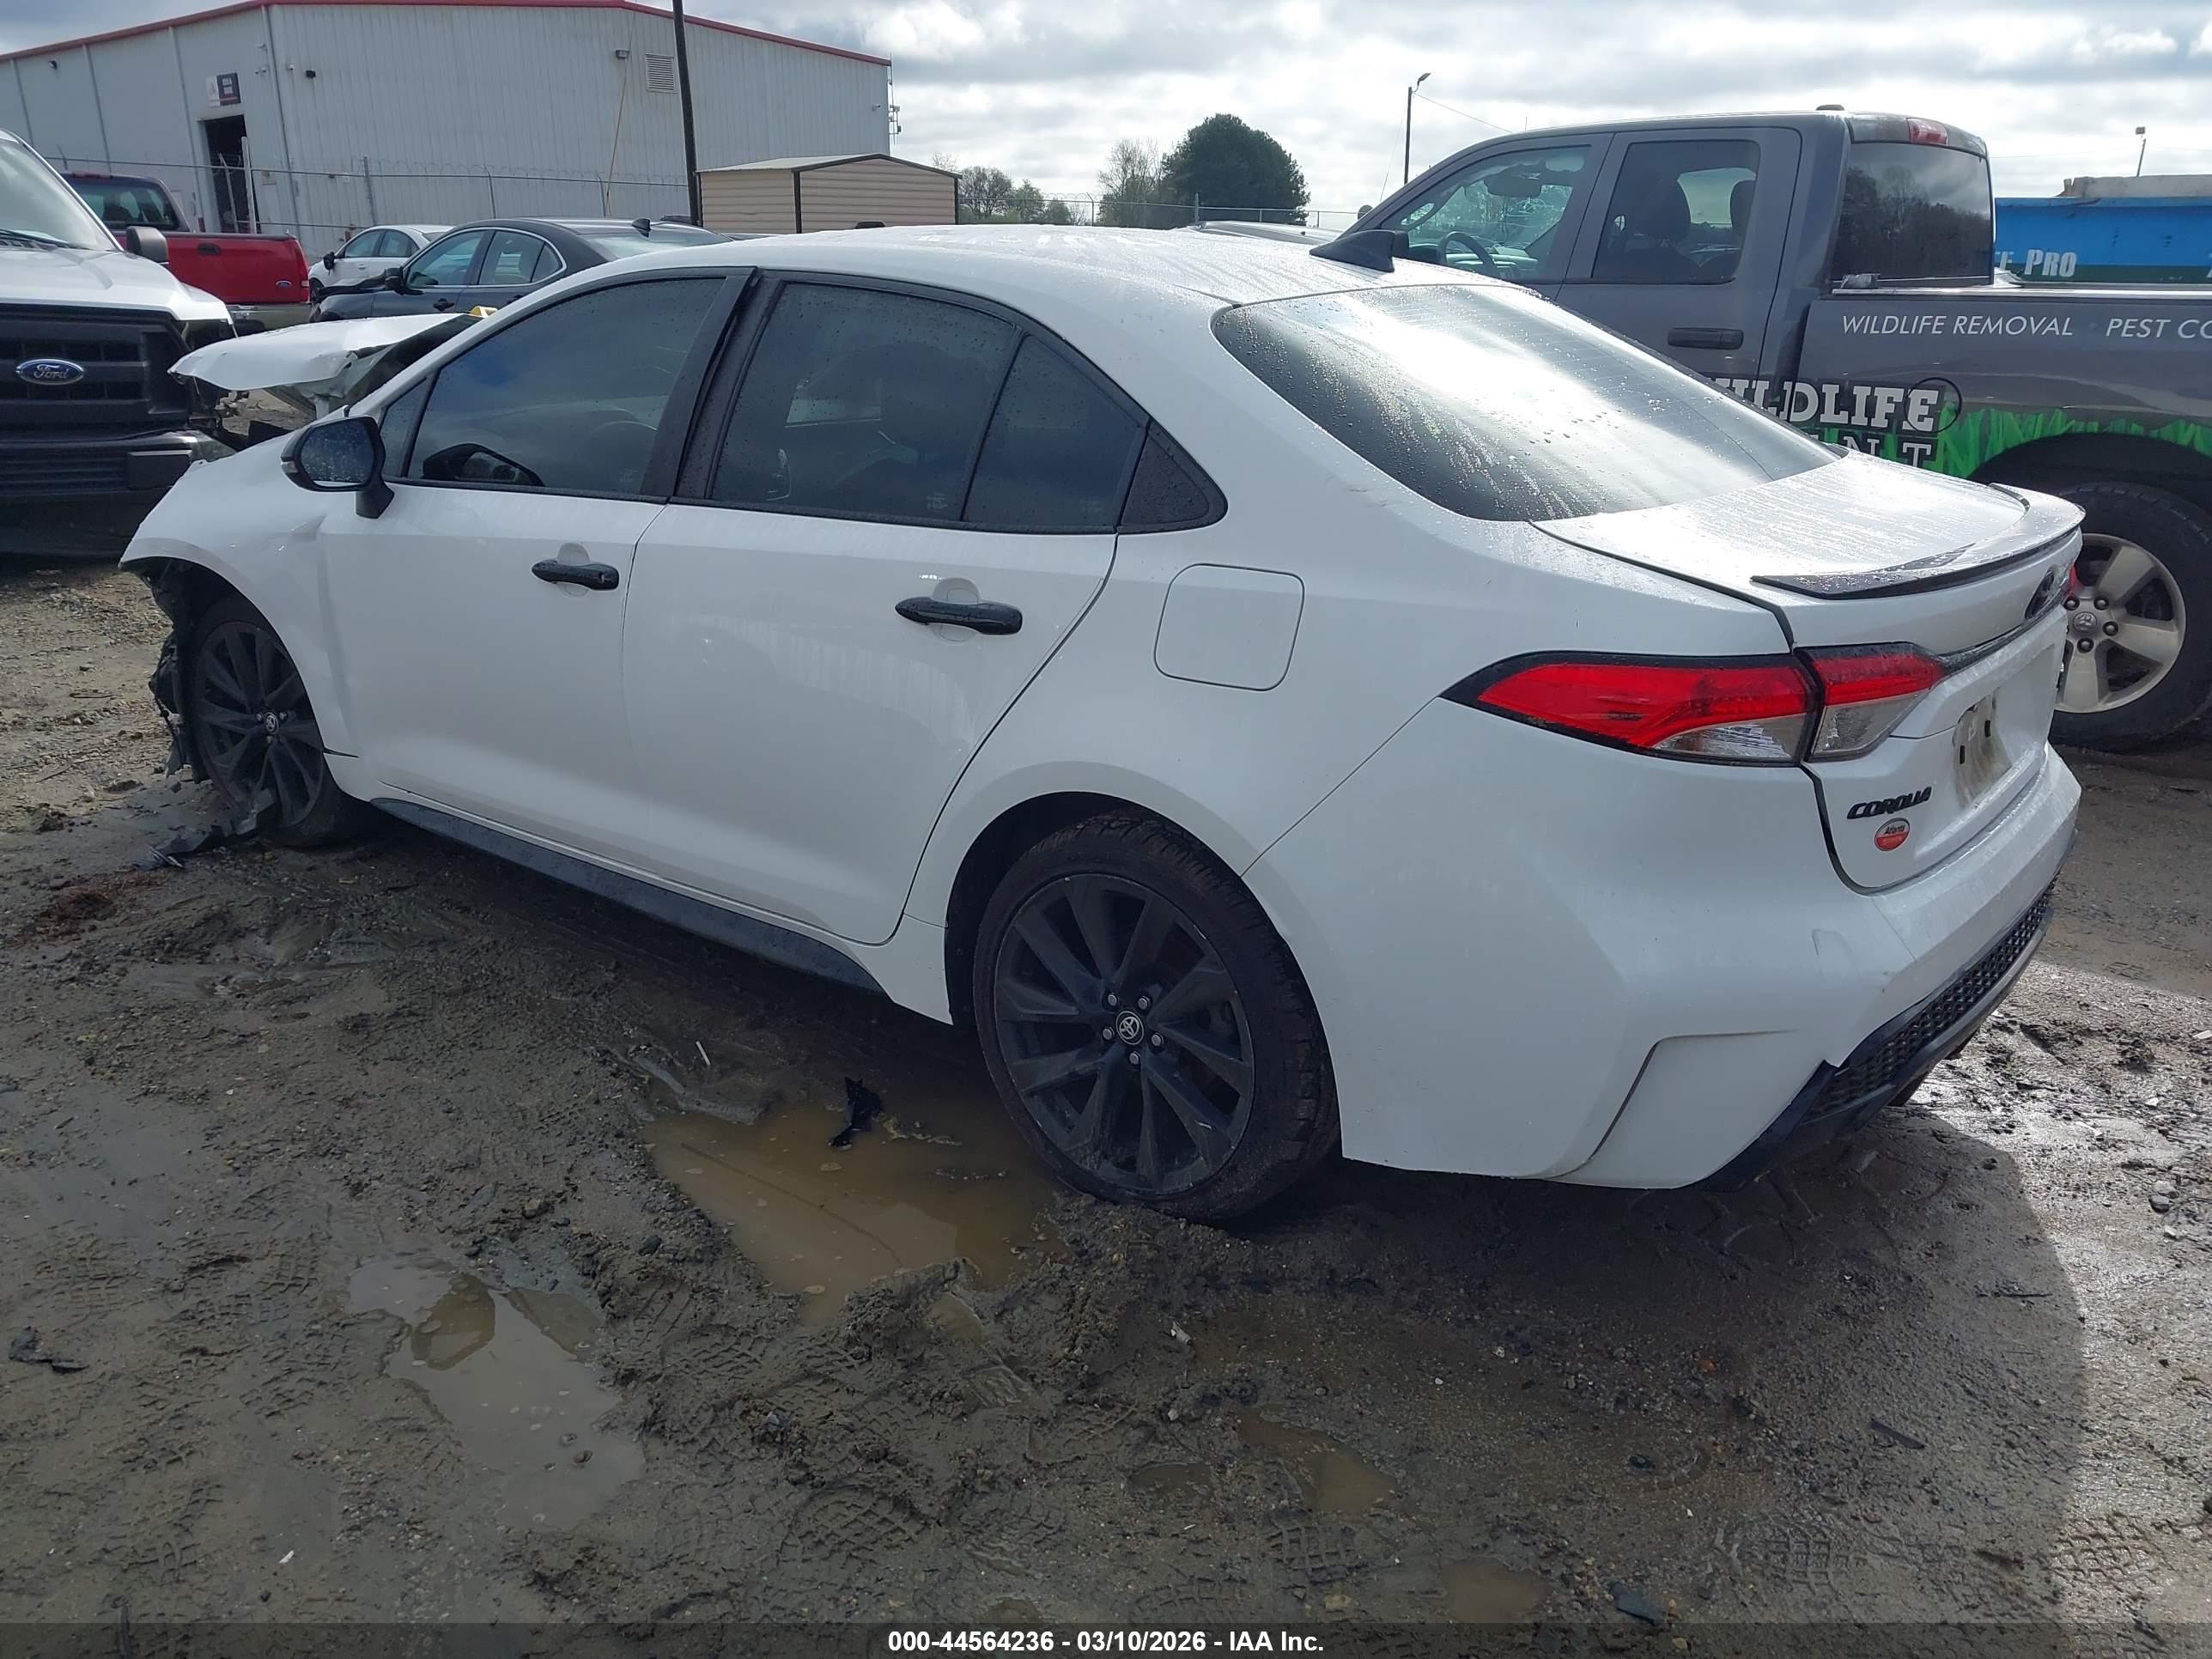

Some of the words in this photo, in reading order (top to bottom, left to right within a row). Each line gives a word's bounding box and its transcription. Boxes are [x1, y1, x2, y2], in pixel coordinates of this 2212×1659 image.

[2024, 249, 2078, 277] PRO
[1843, 315, 1947, 335] WILDLIFE
[1952, 315, 2073, 336] REMOVAL
[2106, 318, 2172, 338] PEST
[33, 363, 70, 379] Ford
[1707, 377, 1939, 432] LDLIFE
[1846, 786, 1932, 819] COROLLA
